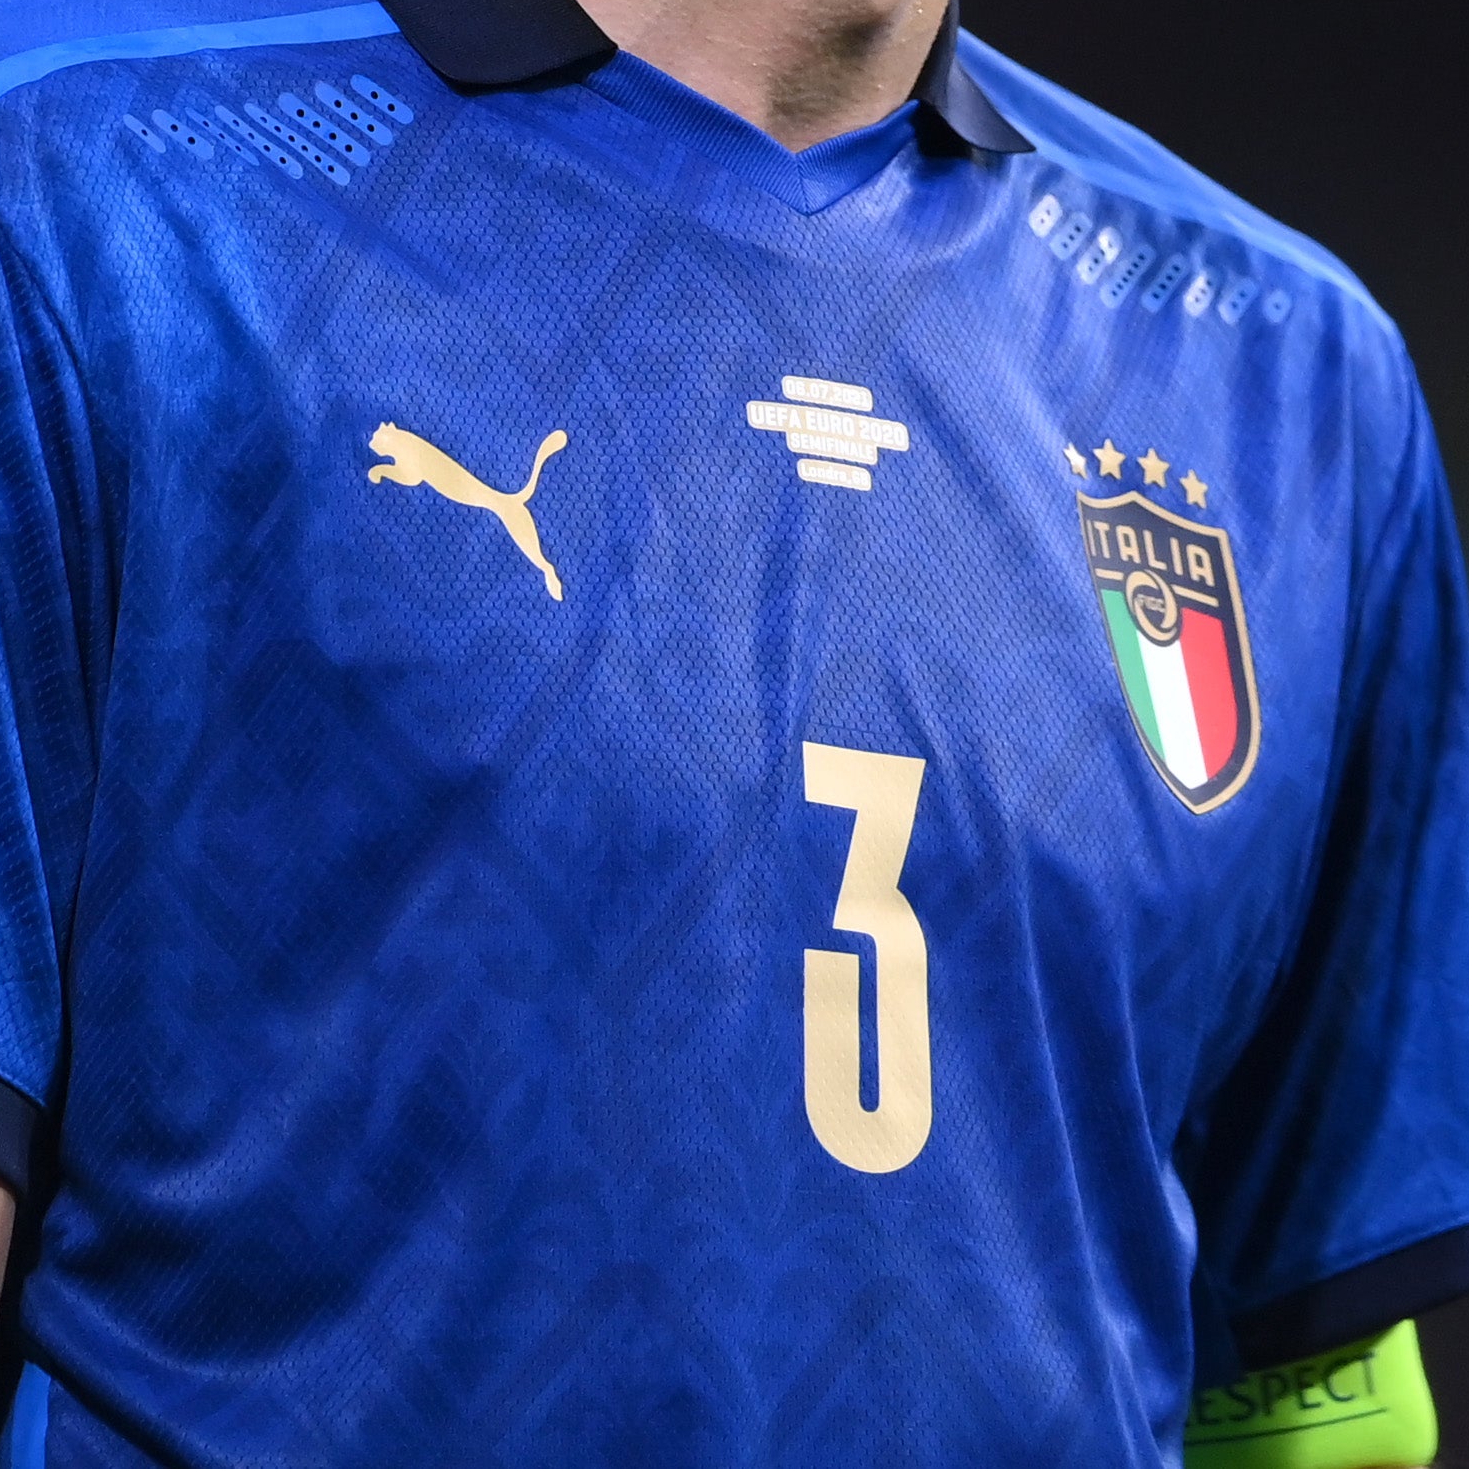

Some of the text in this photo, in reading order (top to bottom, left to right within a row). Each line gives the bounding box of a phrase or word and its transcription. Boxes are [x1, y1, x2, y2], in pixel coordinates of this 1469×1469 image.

[750, 404, 904, 446] UEFA EURO 2020
[790, 434, 874, 460] SEMIFINALE
[1087, 520, 1215, 587] ITALIA
[803, 741, 932, 1173] 3
[1186, 1351, 1377, 1425] ESPECT
